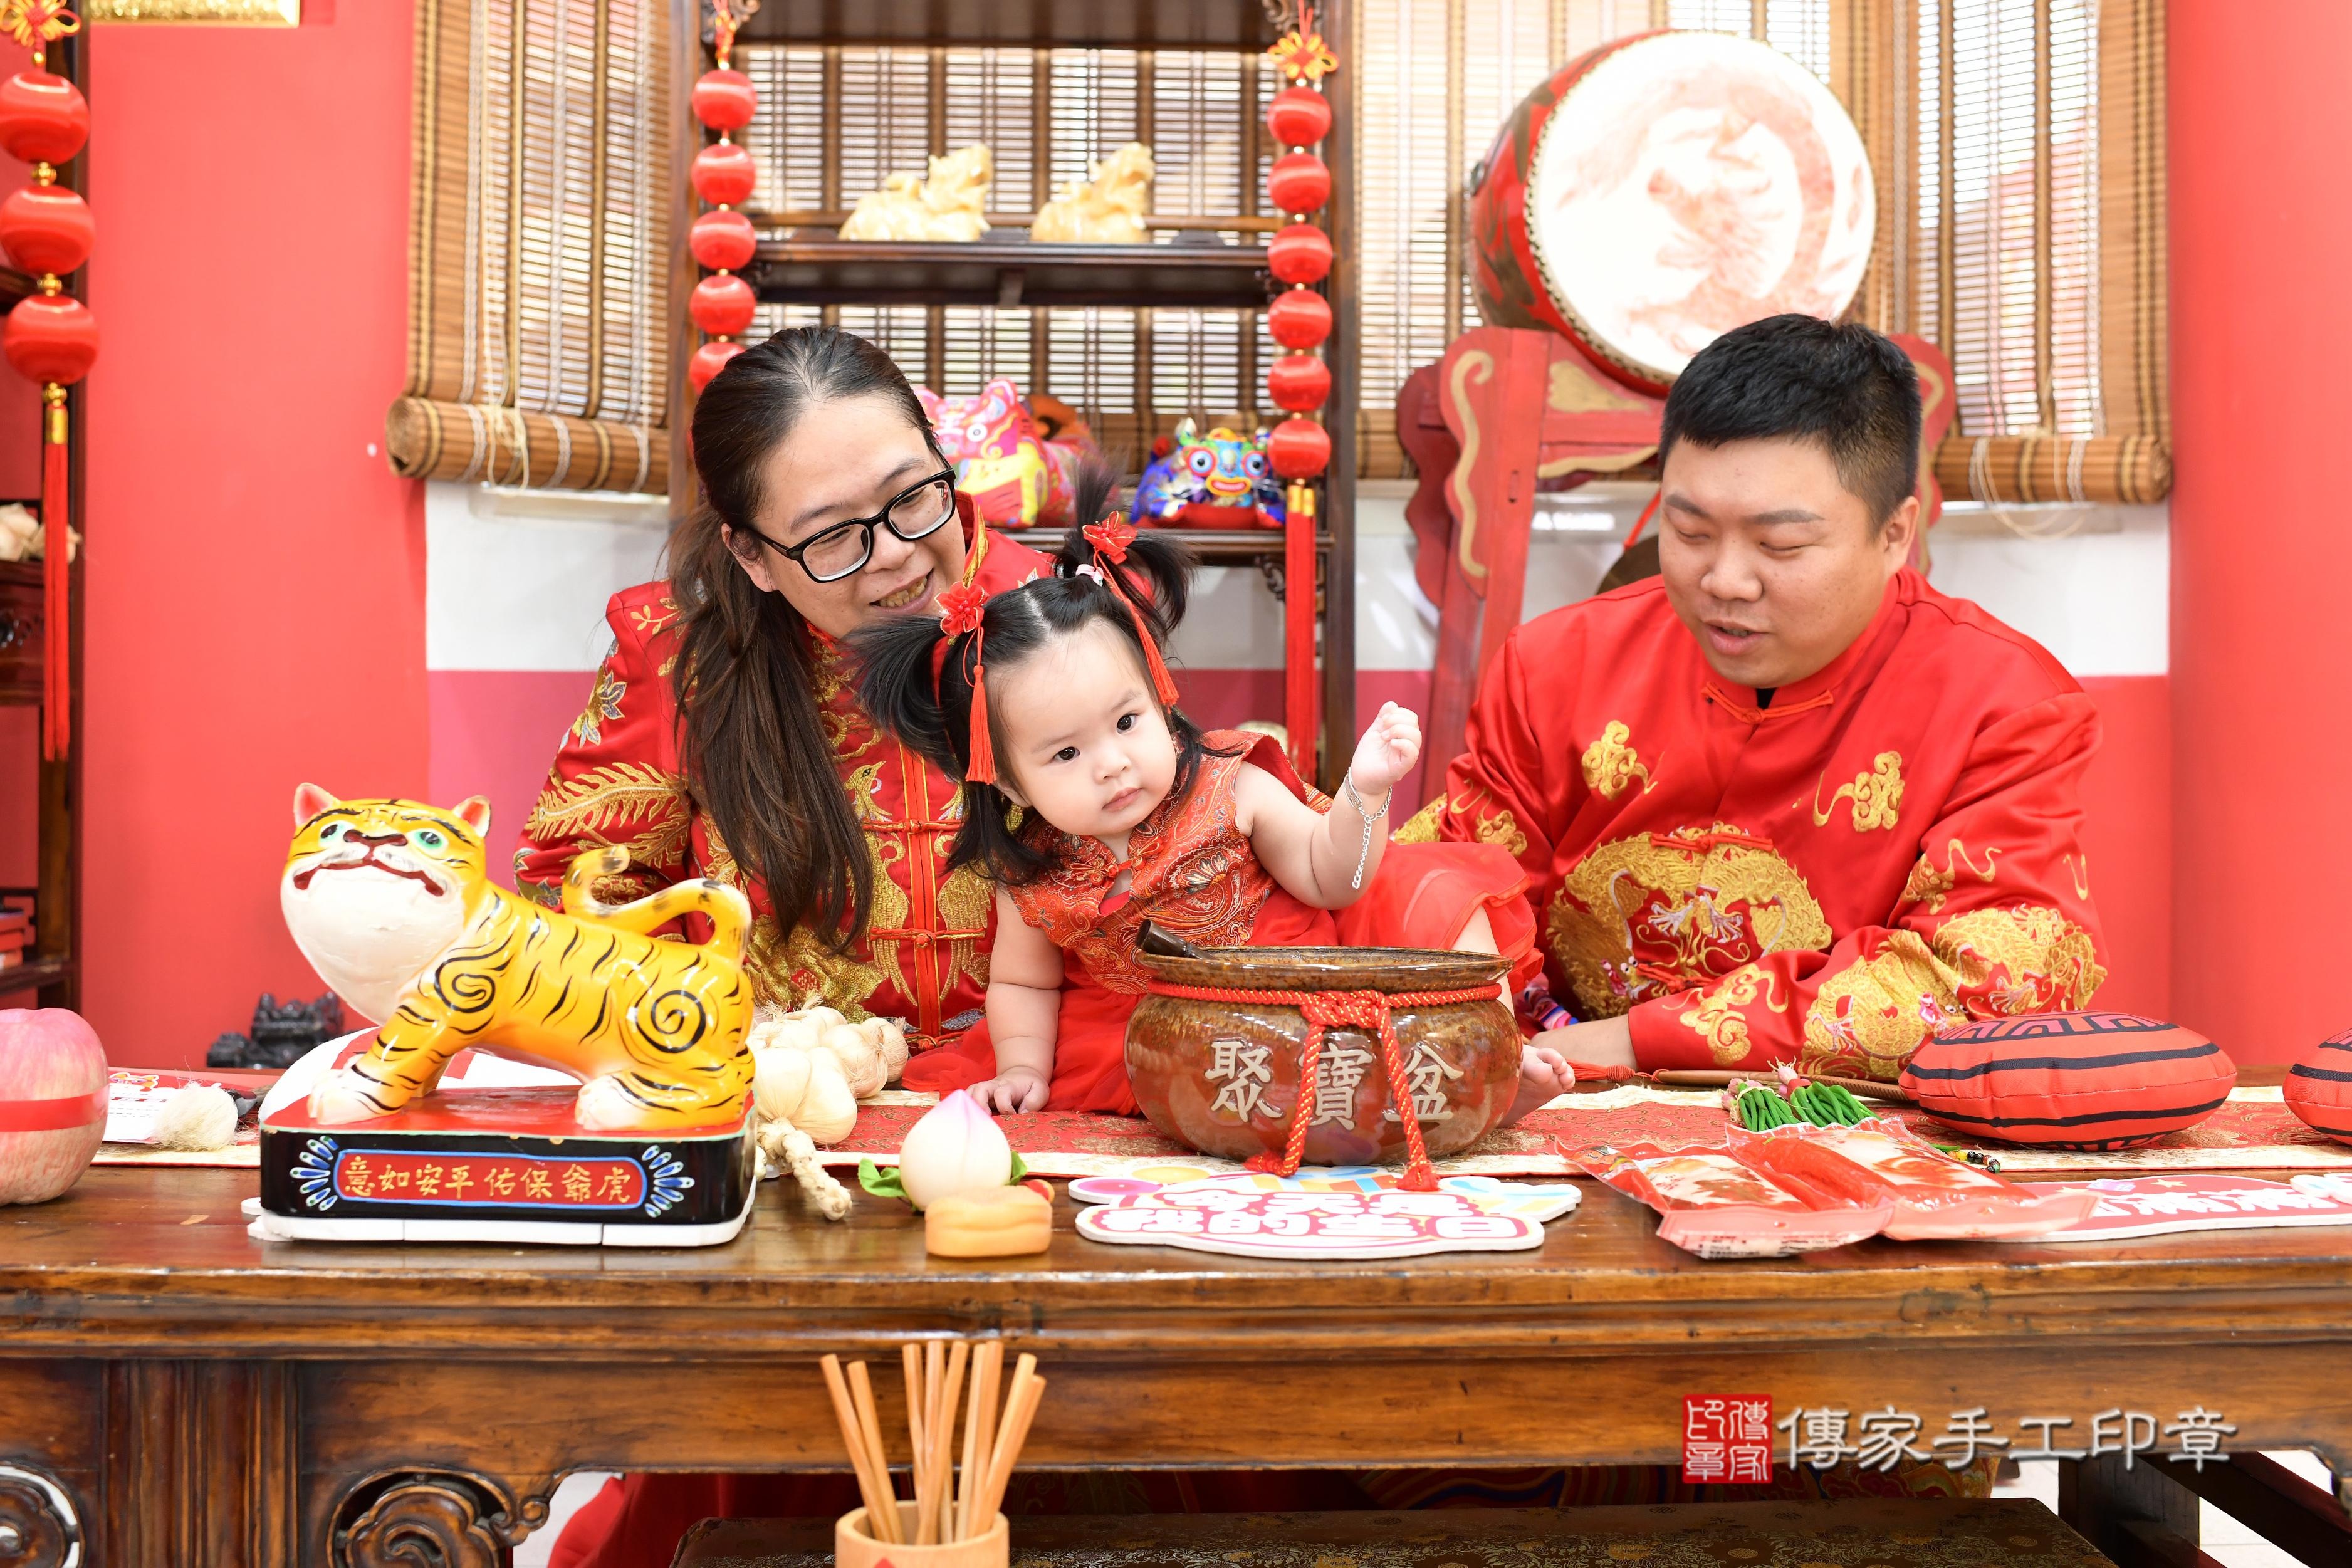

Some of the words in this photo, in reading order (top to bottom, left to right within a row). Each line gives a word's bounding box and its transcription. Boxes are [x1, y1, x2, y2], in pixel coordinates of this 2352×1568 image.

[1204, 1040, 1465, 1131] 聚寶盆
[1160, 1190, 1482, 1216] 今天是
[2092, 1188, 2338, 1216] 滿滿
[1100, 1209, 1521, 1238] 我的生日
